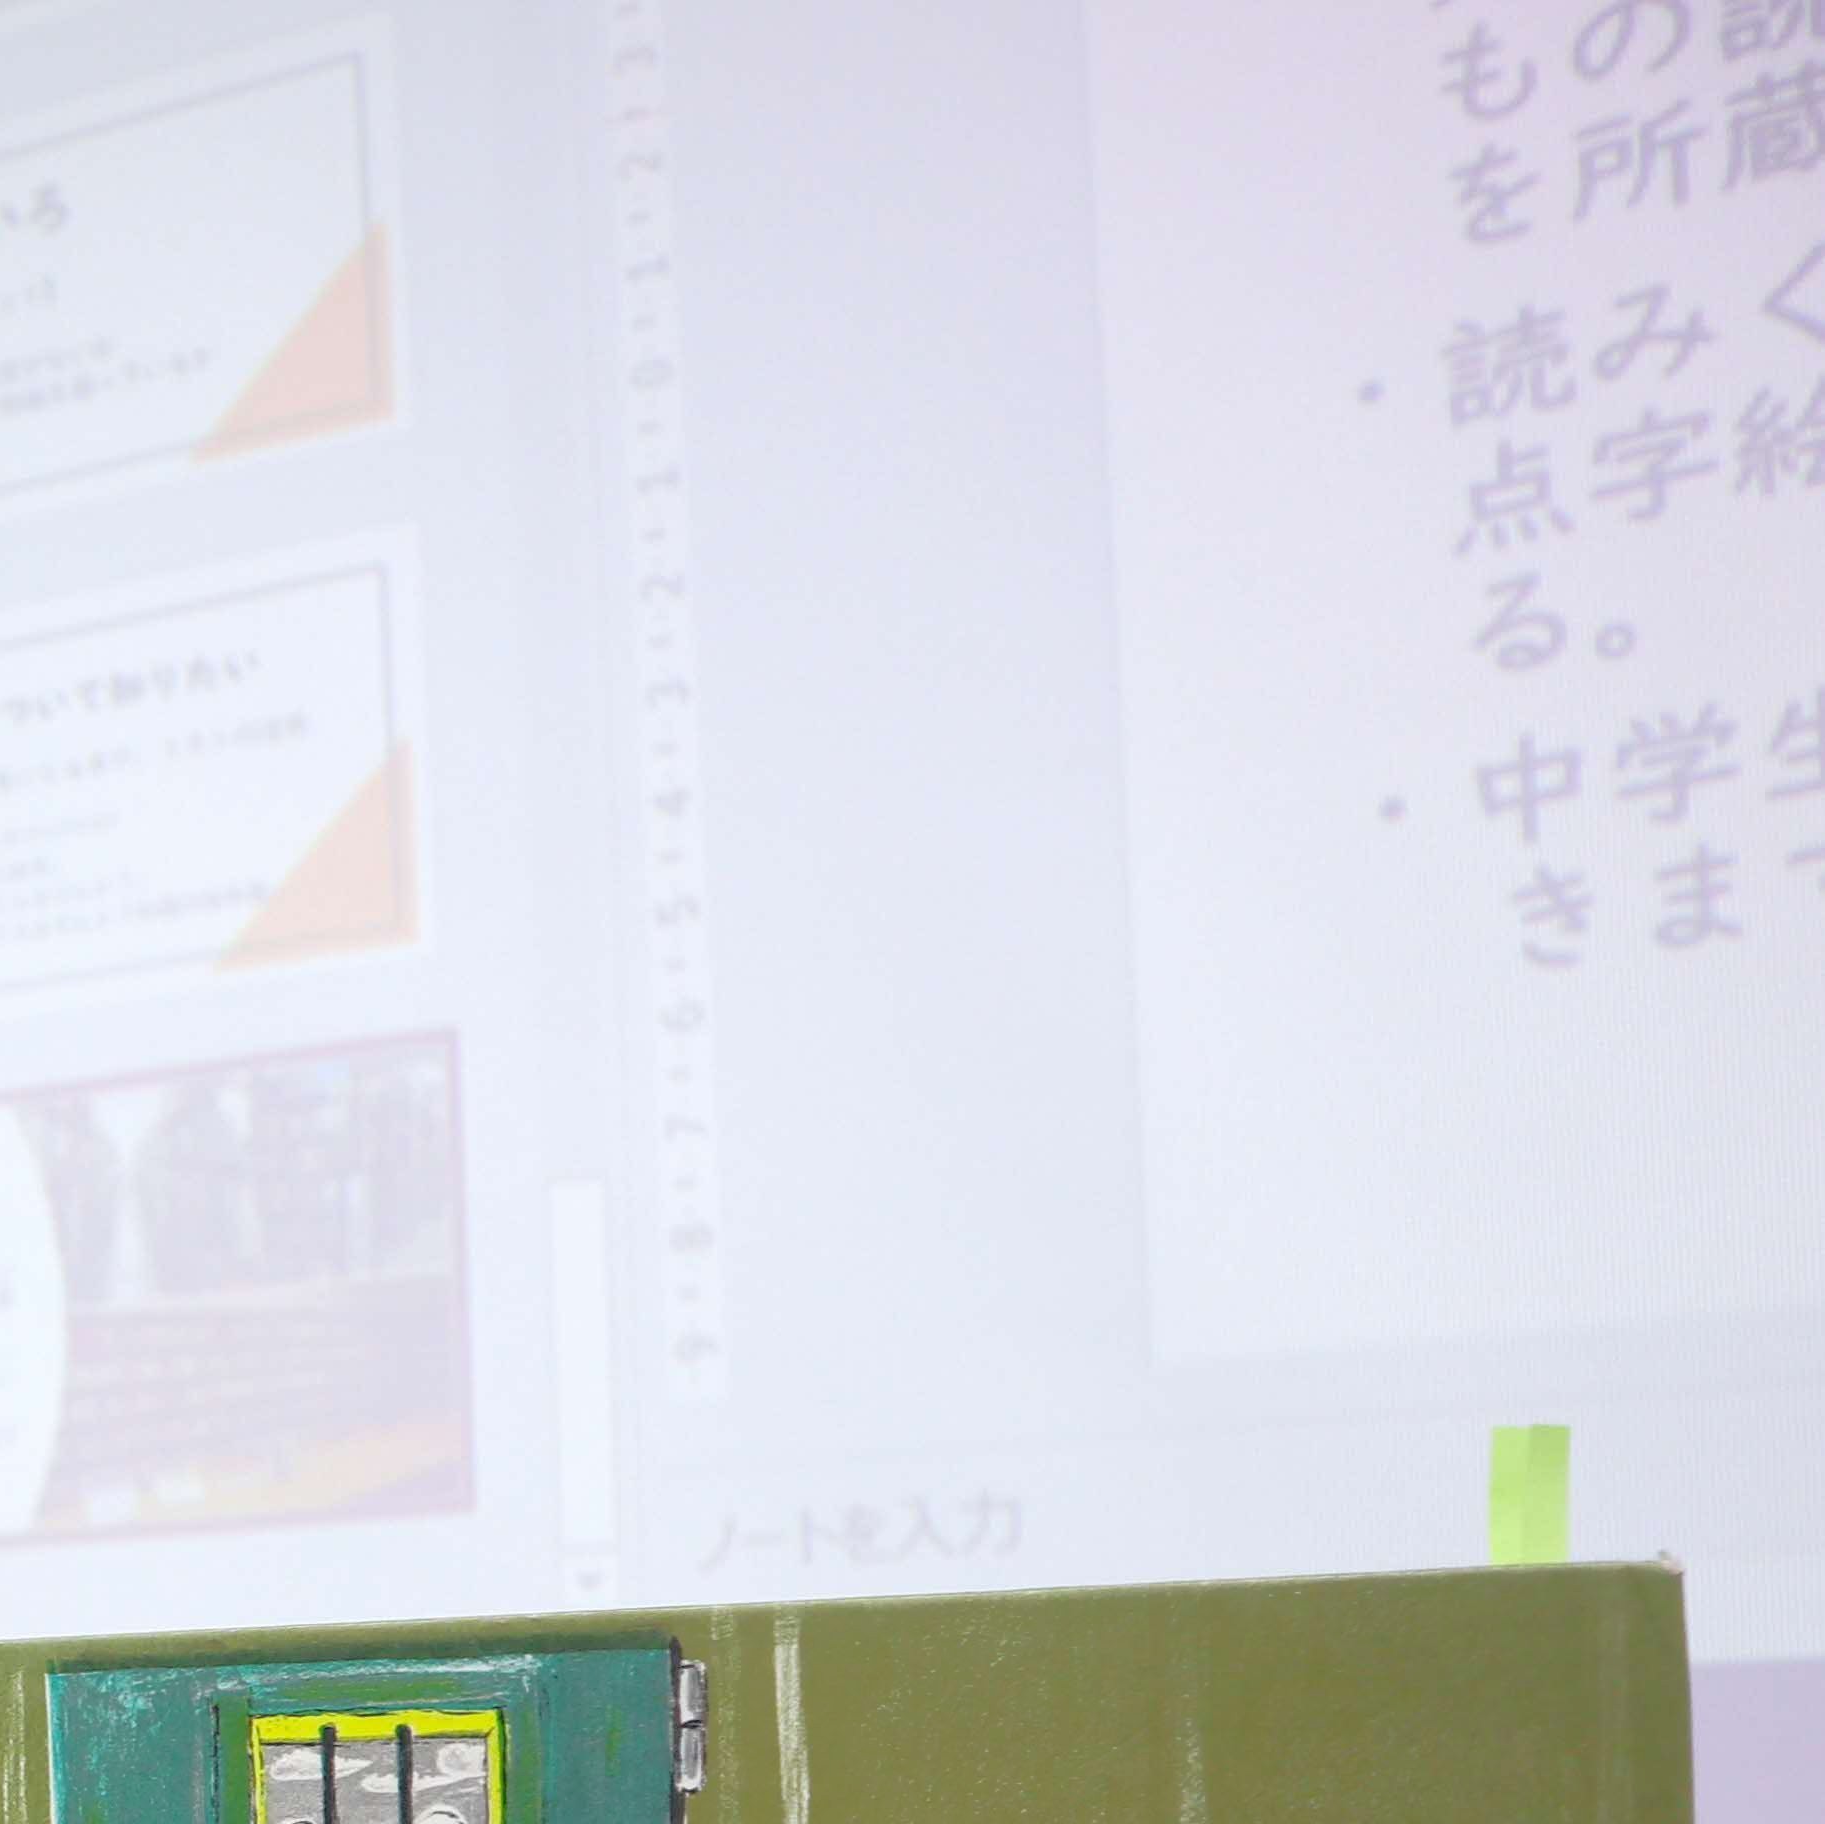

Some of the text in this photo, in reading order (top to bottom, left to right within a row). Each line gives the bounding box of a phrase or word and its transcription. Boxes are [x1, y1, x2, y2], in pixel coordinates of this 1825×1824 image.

[1471, 572, 1637, 674] る。
[697, 1489, 1022, 1578] ノートを入力
